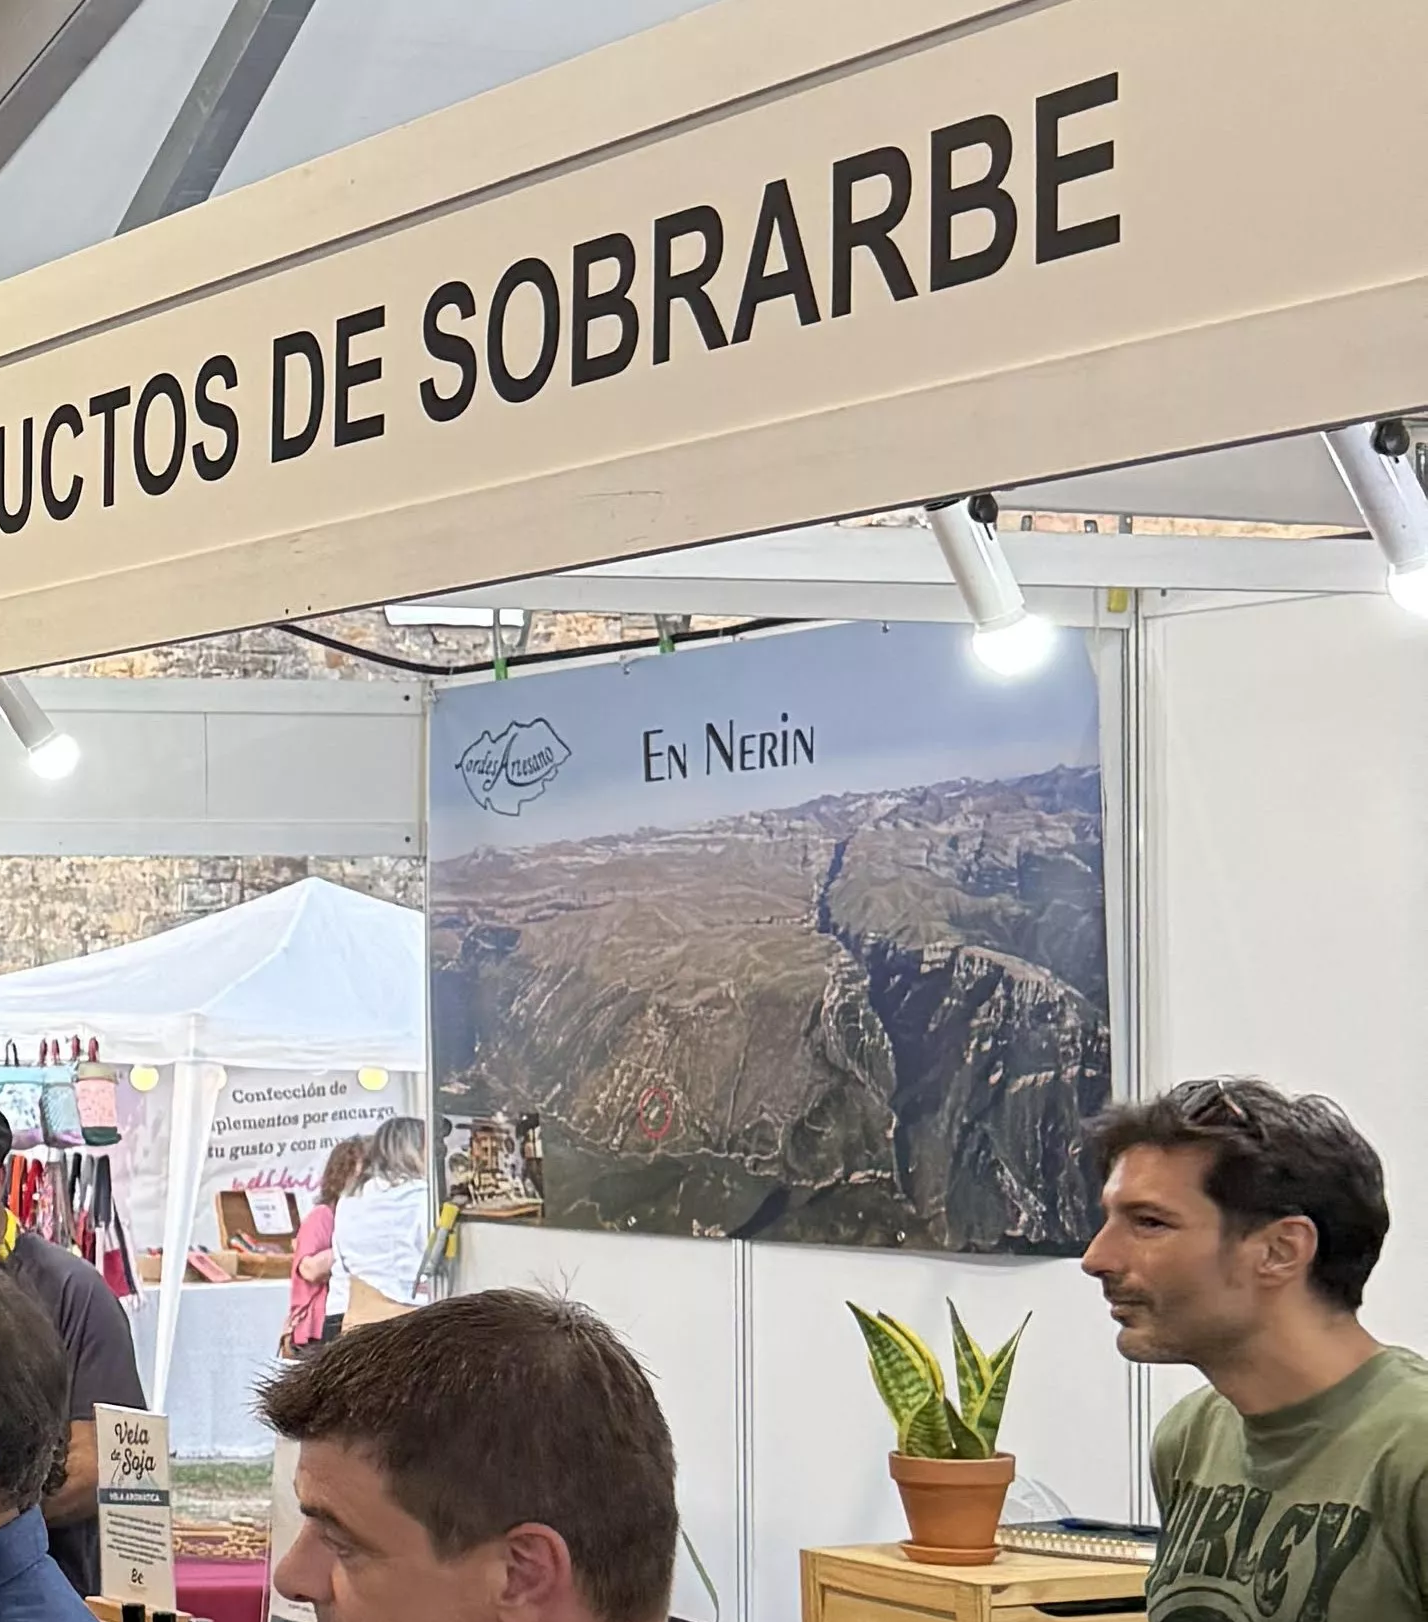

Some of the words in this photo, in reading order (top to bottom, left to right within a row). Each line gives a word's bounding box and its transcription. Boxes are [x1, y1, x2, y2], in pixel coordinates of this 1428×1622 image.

[270, 304, 386, 465] DE
[418, 70, 1124, 424] SOBRARBE
[232, 1083, 326, 1104] Confección
[330, 1081, 347, 1096] de
[212, 1114, 299, 1134] plementos
[302, 1113, 328, 1129] por
[229, 1144, 273, 1161] gusto
[276, 1144, 287, 1157] y
[290, 1140, 316, 1152] con
[114, 1421, 149, 1446] Vela
[122, 1448, 156, 1480] Soja
